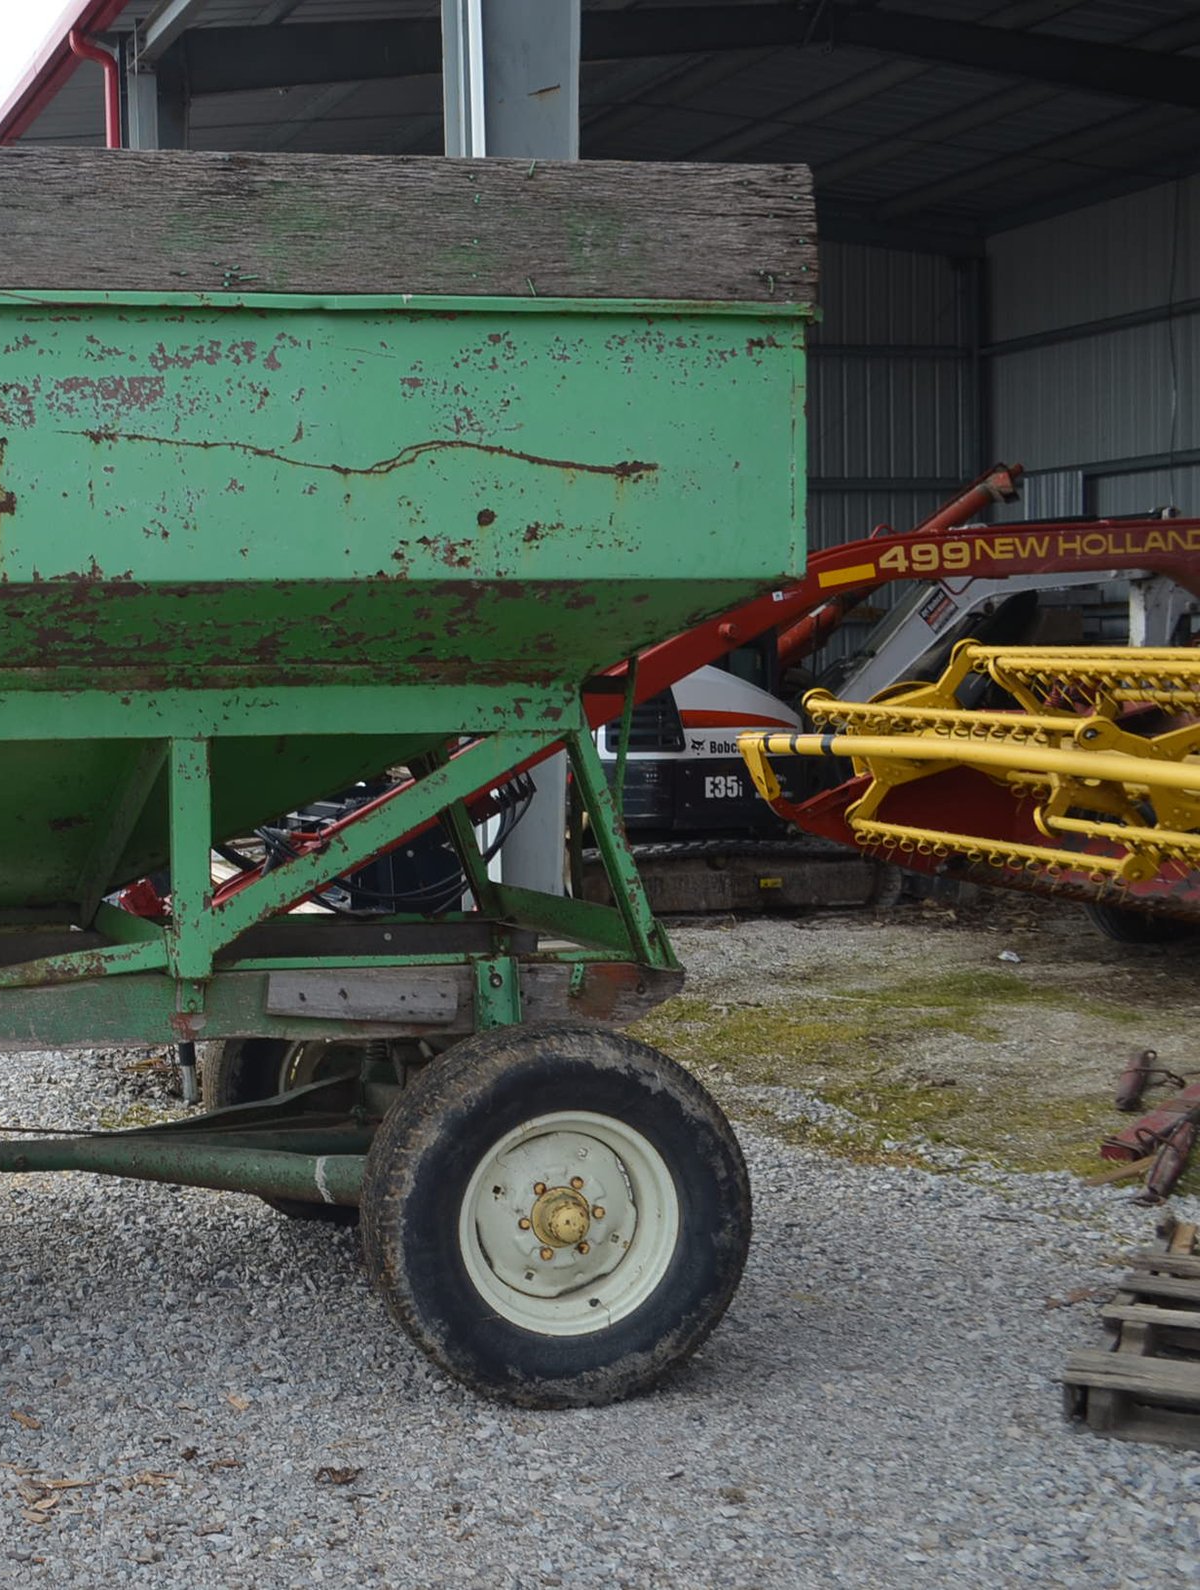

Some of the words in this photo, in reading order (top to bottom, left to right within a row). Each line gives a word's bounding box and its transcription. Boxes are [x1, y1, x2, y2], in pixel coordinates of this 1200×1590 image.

[879, 541, 971, 573] 499
[975, 535, 1050, 561] NEW
[710, 740, 741, 754] Bobc
[704, 775, 743, 799] E35i
